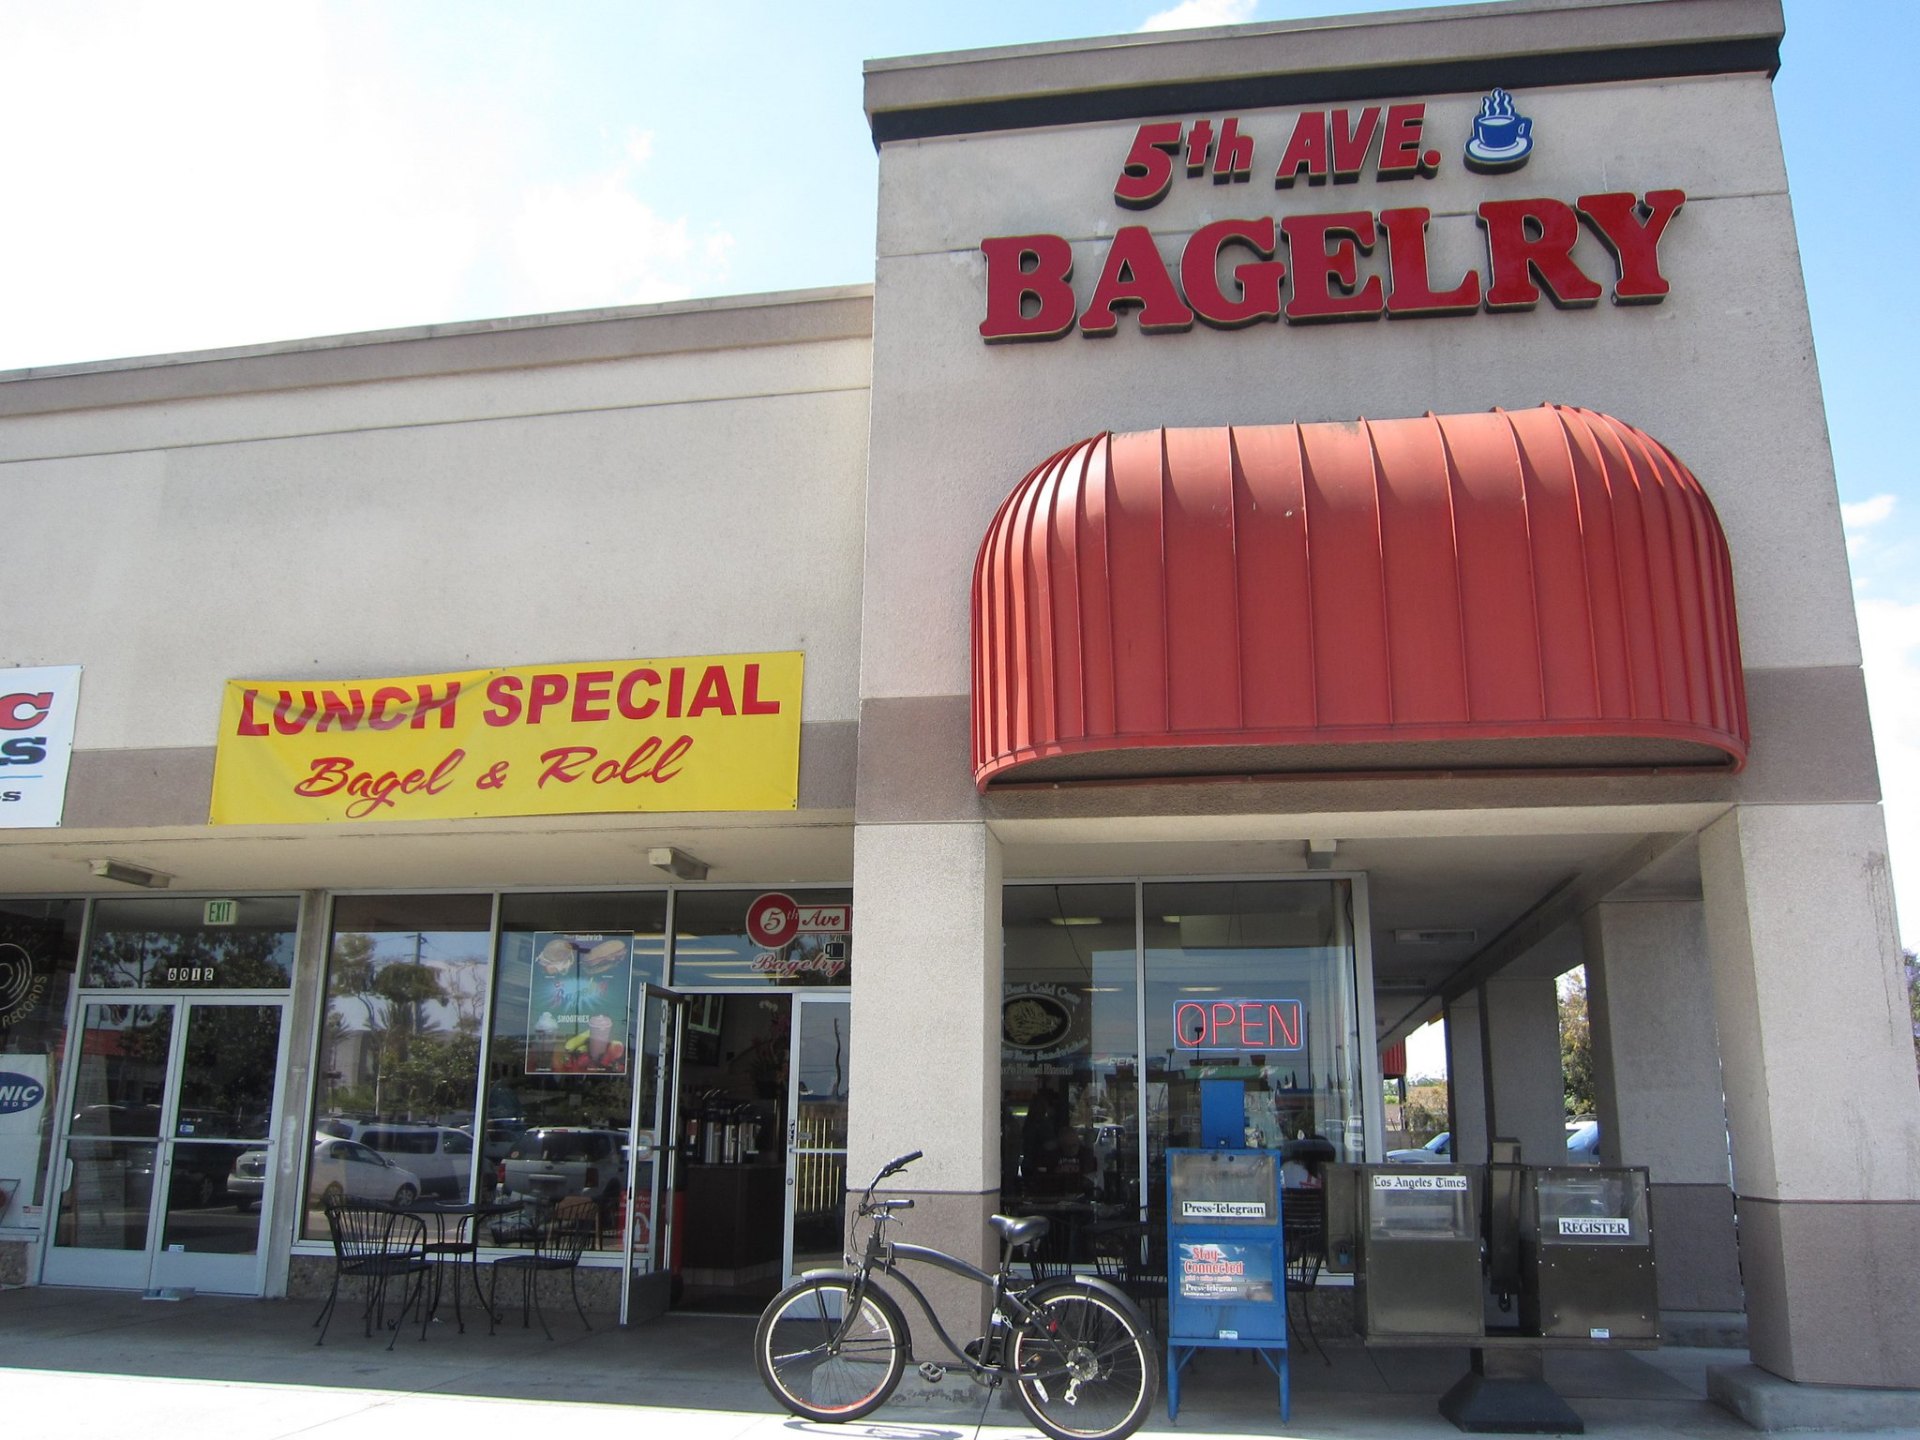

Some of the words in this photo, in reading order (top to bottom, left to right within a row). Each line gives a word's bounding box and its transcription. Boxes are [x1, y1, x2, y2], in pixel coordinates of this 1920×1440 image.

[1114, 118, 1255, 207] 5th
[1276, 104, 1442, 187] AVE.
[979, 189, 1686, 343] BAGELRY
[236, 680, 461, 736] LUNCH
[483, 663, 781, 727] SPECIAL
[0, 737, 47, 766] S
[294, 748, 467, 819] Bagel
[476, 760, 510, 790] &
[538, 735, 695, 786] Roll
[208, 901, 232, 922] EXIT
[801, 909, 841, 927] Ave
[168, 967, 214, 981] 6012
[751, 952, 846, 977] Bagelry
[2, 975, 48, 1028] RECORDS
[557, 1014, 590, 1023] SMOOTHIES
[1176, 1003, 1299, 1047] OPEN
[1374, 1176, 1392, 1188] Los
[1394, 1176, 1433, 1190] Angeles
[1435, 1177, 1466, 1188] Times
[1183, 1202, 1265, 1216] Press-Telegram
[1561, 1221, 1628, 1234] REGISTER
[1192, 1247, 1219, 1262] Stay
[1184, 1260, 1244, 1276] Connected
[1184, 1283, 1238, 1293] Press-Telegram
